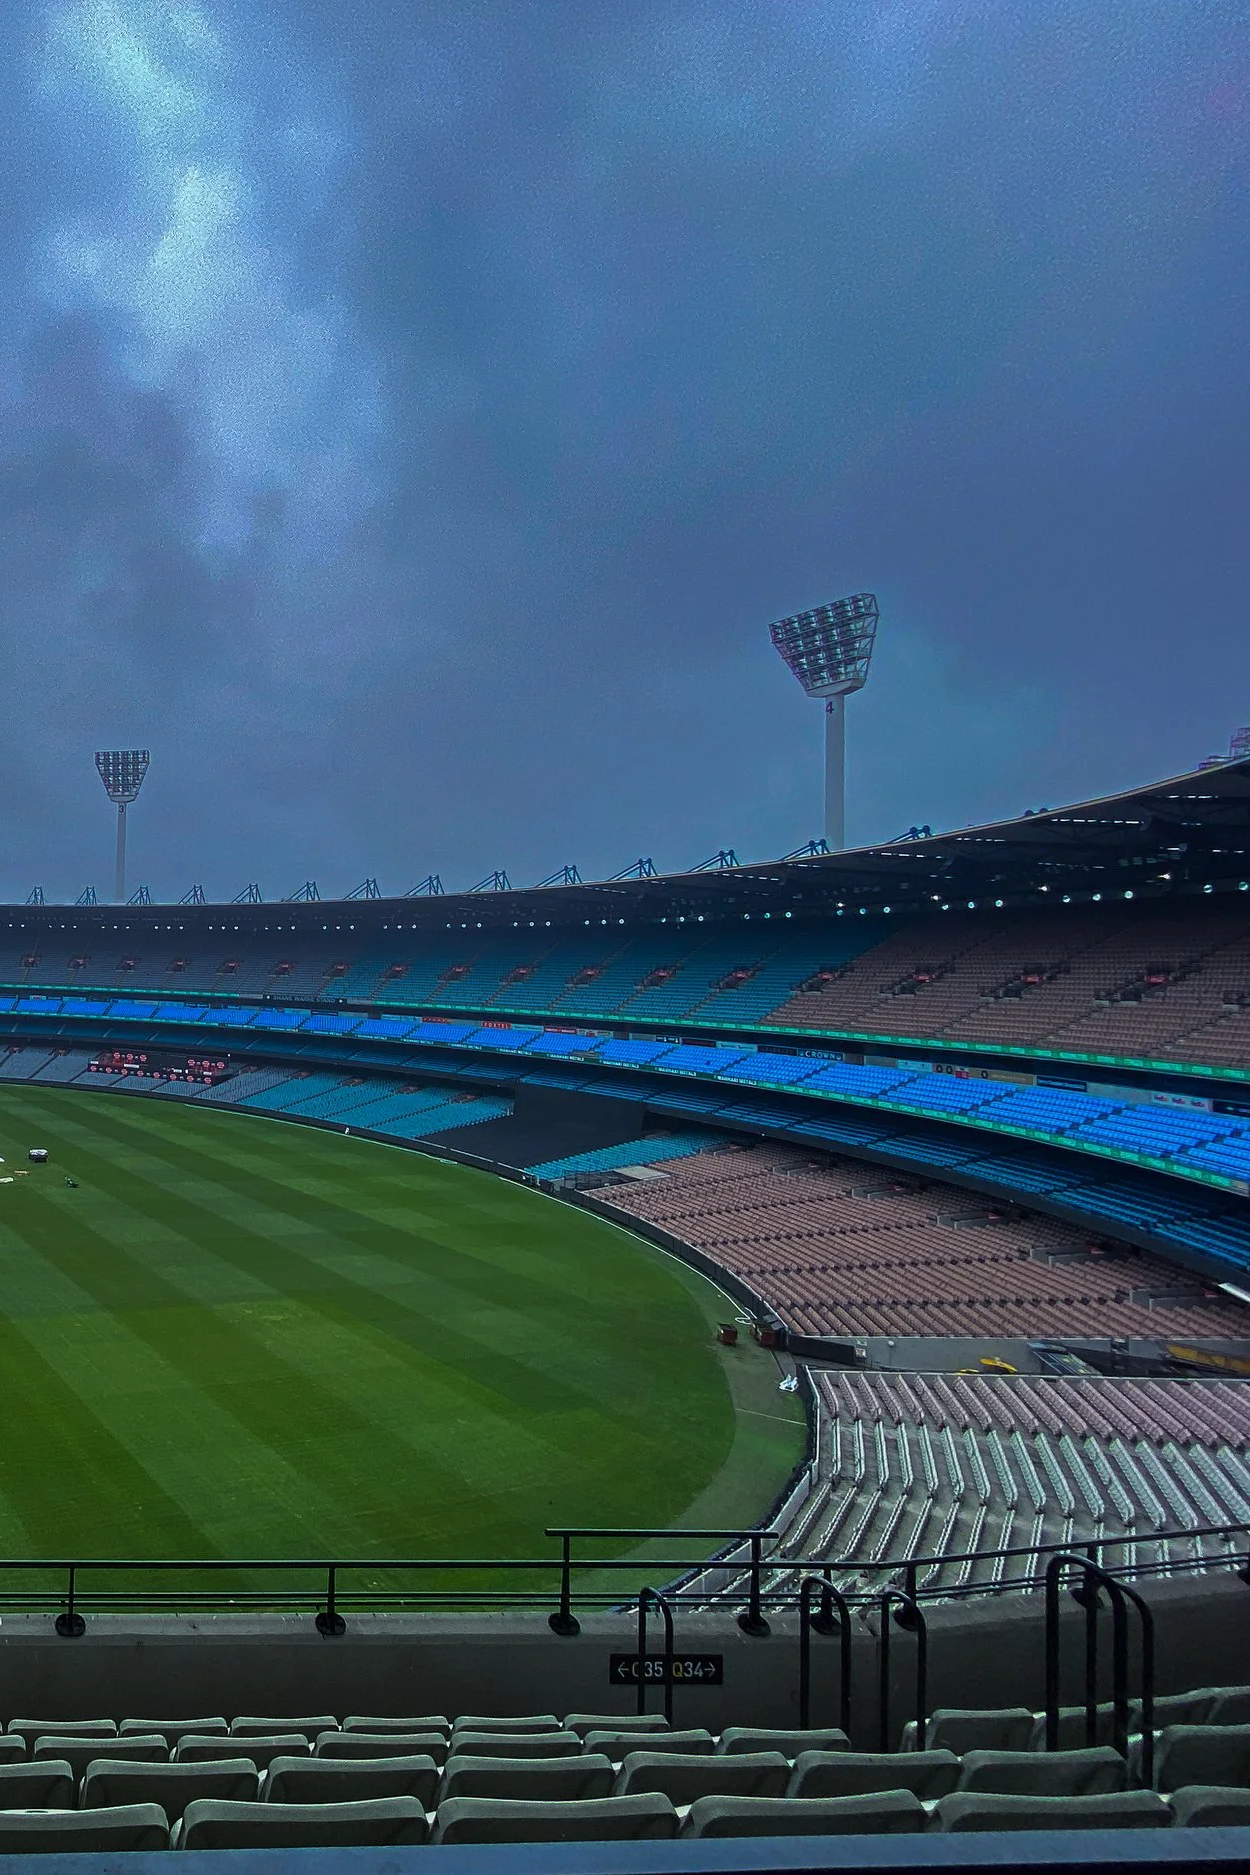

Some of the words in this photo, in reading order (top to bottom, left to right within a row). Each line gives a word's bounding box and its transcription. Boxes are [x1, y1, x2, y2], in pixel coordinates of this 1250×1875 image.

[826, 701, 834, 714] 4
[118, 805, 124, 813] 3
[805, 1050, 835, 1060] CROWN
[672, 1661, 703, 1678] Q34
